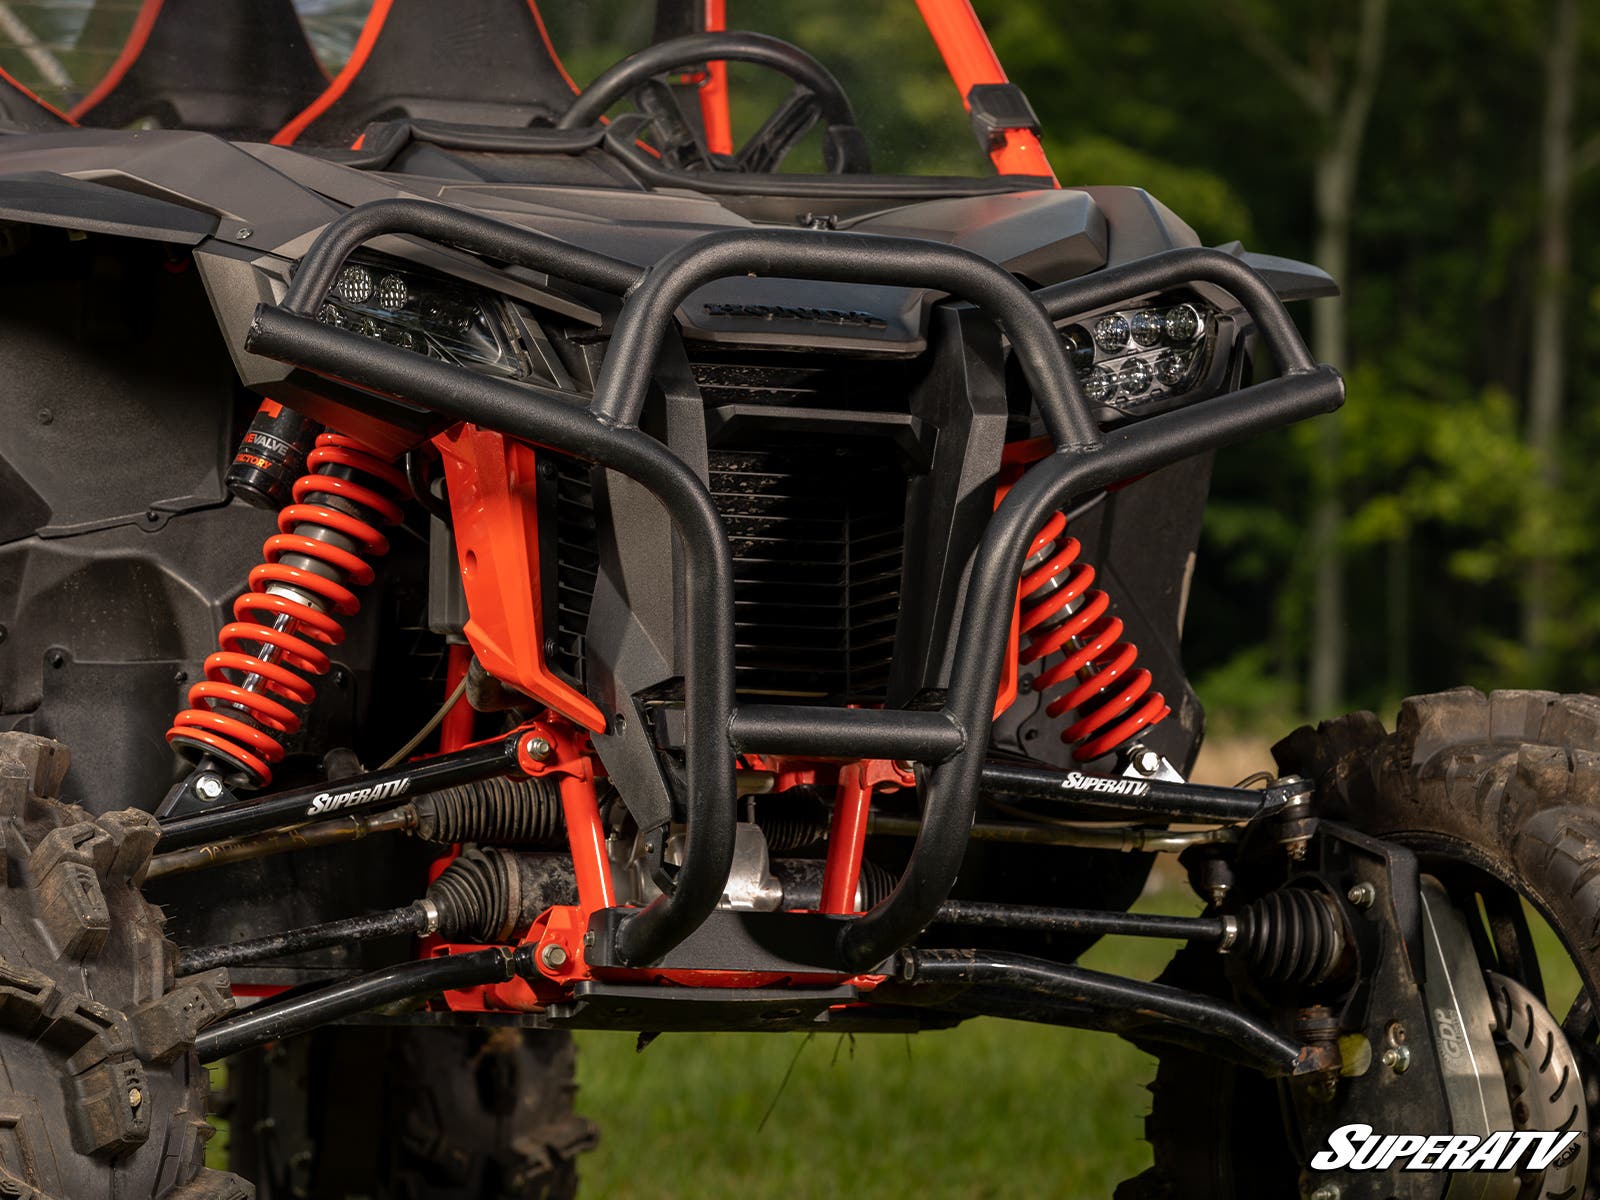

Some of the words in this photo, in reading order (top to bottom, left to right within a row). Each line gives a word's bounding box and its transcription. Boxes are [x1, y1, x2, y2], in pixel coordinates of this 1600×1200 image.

[307, 778, 409, 815] SUPERATV
[1062, 772, 1147, 795] SUPERATV
[1434, 1008, 1461, 1058] GDP
